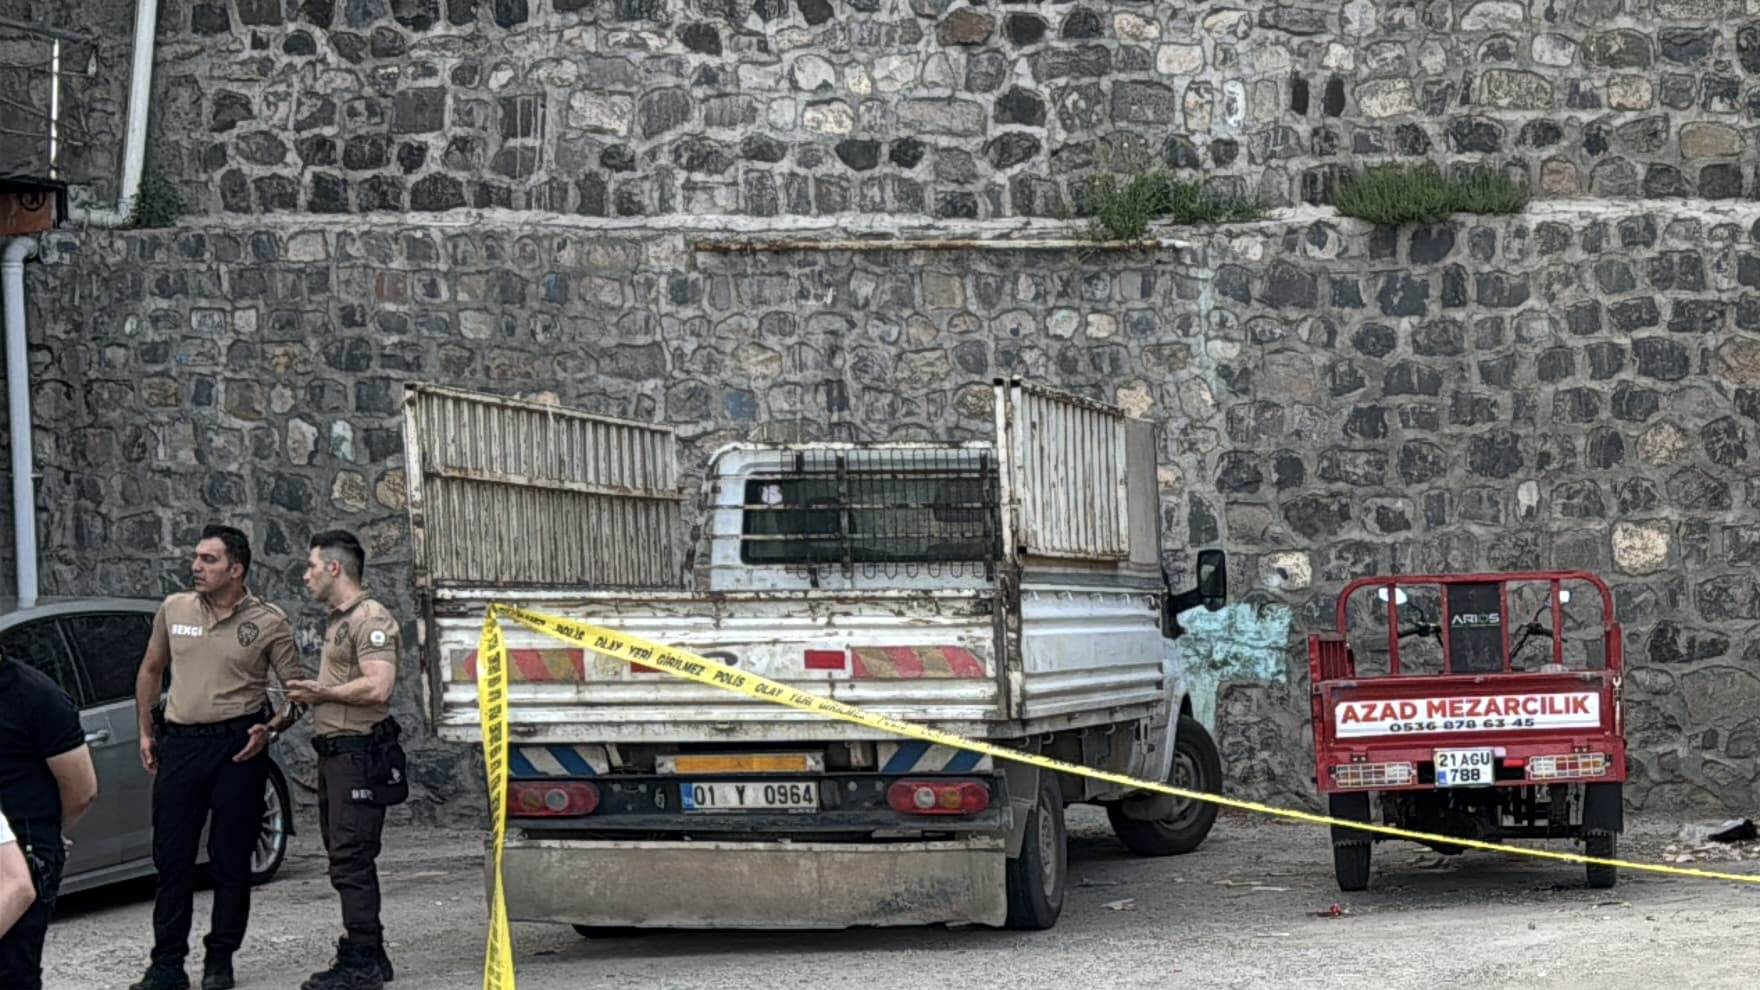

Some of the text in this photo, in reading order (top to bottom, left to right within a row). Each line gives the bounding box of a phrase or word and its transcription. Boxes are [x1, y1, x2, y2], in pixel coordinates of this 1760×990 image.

[1341, 695, 1590, 724] AZAD MEZARCILIK
[1389, 721, 1437, 733] 0536
[1511, 718, 1536, 728] 45
[1438, 751, 1491, 767] 21 AGU
[1449, 768, 1481, 782] 788
[694, 784, 814, 806] 01 Y 0964
